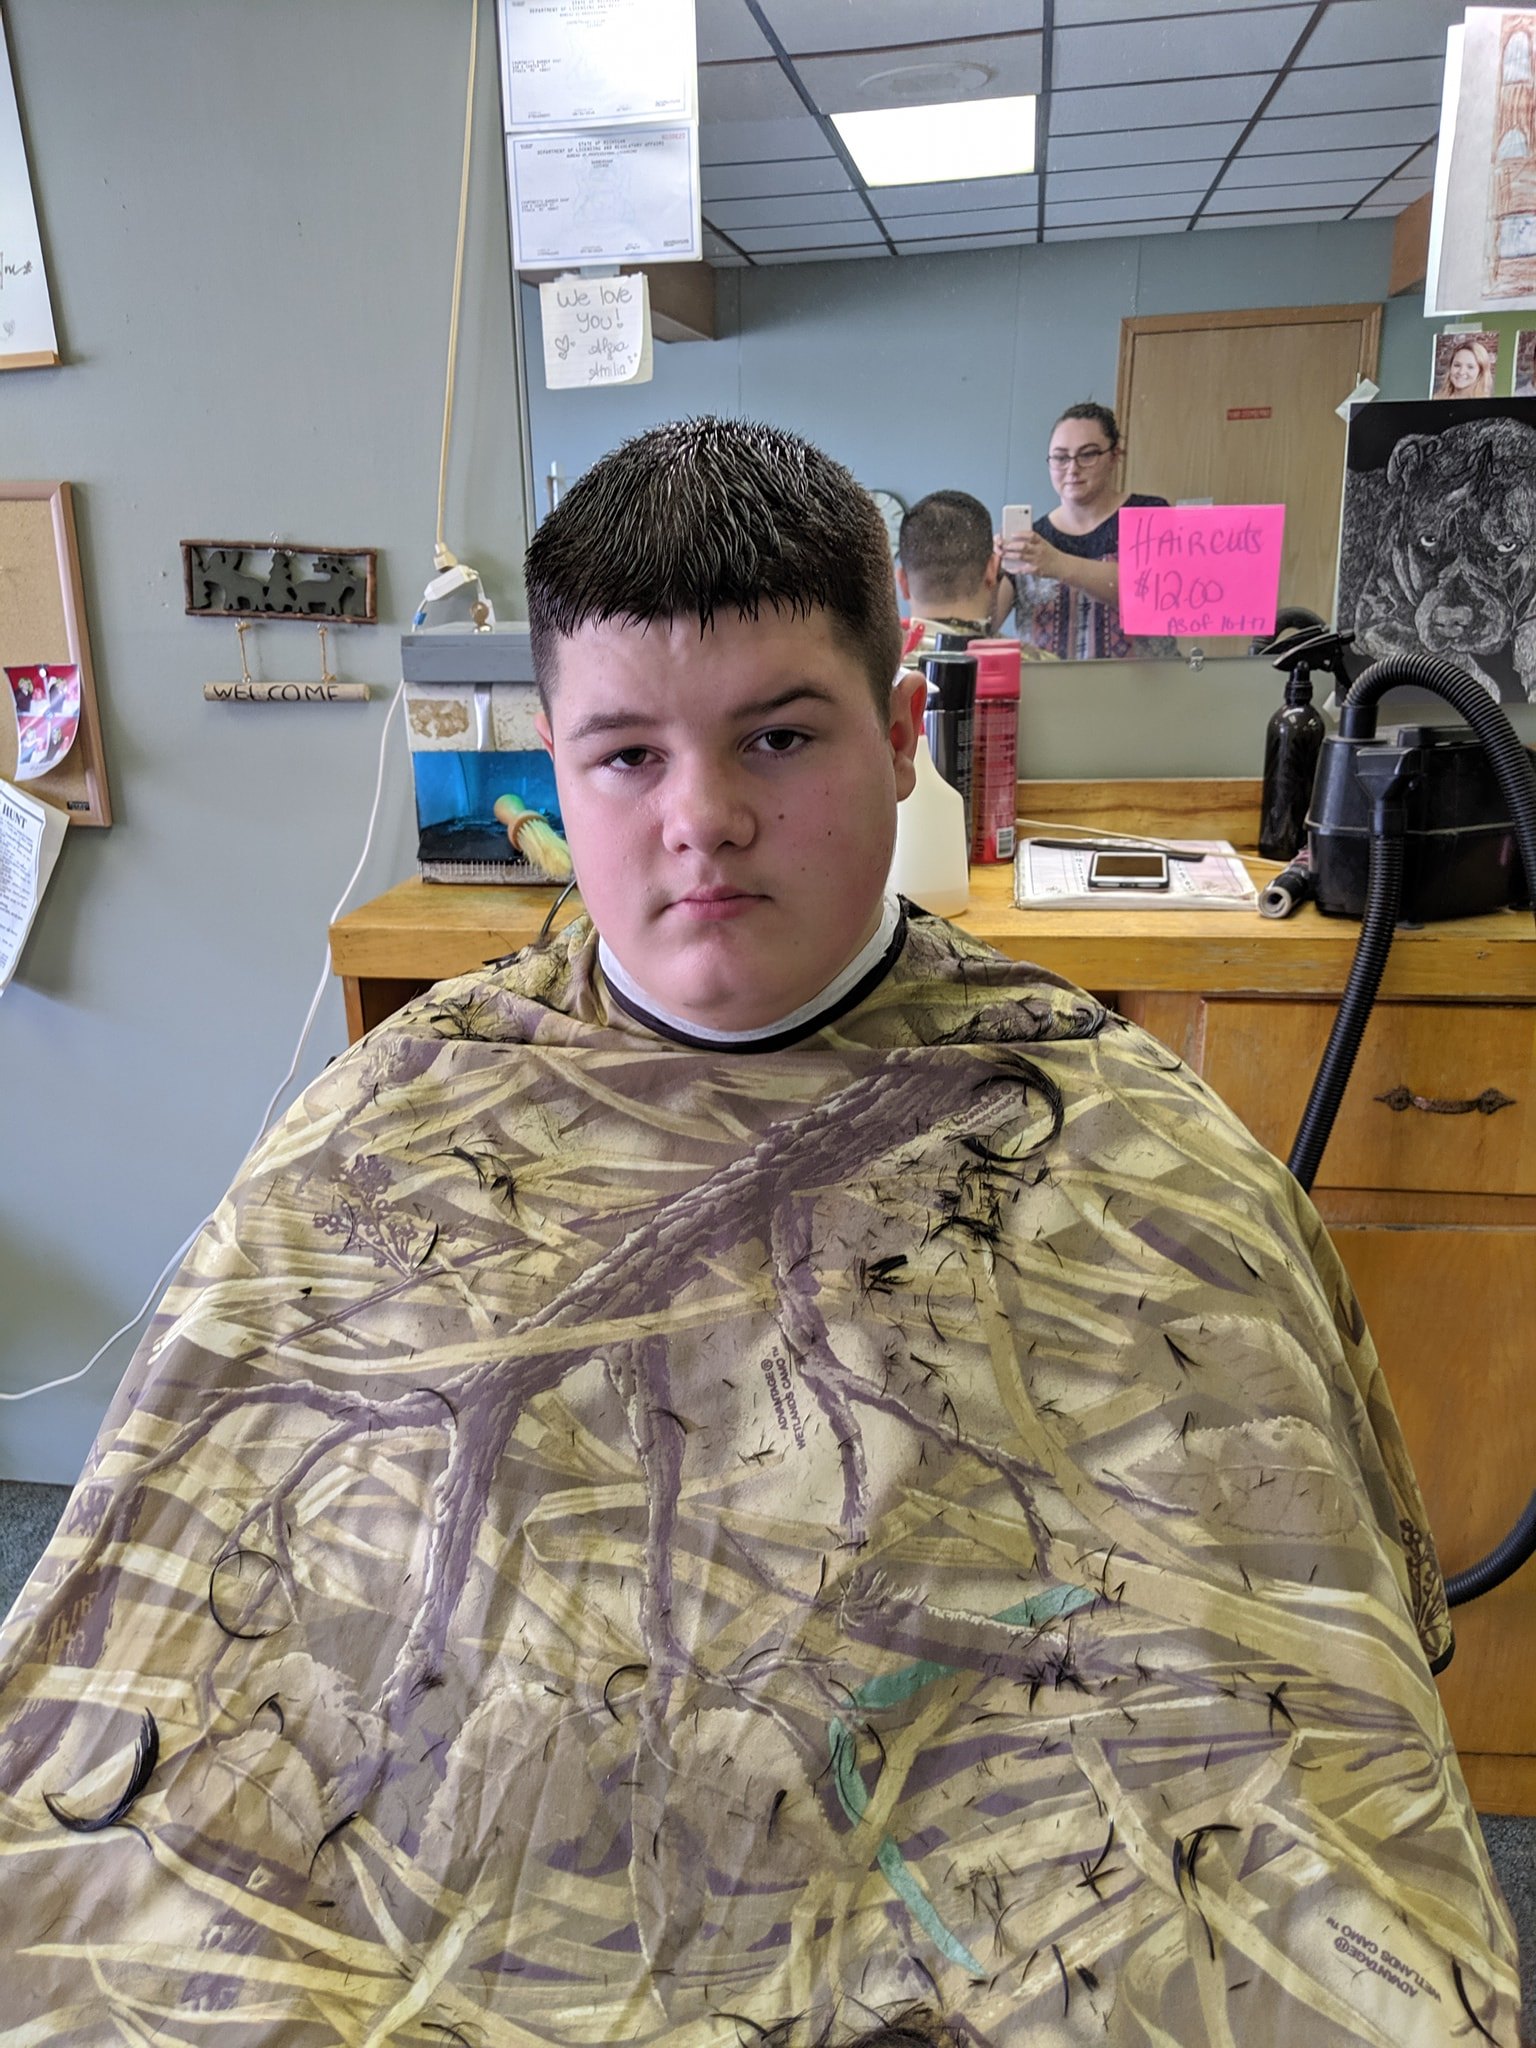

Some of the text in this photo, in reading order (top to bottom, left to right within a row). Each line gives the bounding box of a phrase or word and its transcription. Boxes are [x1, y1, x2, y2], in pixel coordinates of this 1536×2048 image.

[557, 286, 633, 308] We love
[576, 308, 624, 333] you!
[1134, 568, 1224, 611] $12.00
[2, 803, 27, 829] HUNT
[776, 1358, 792, 1389] CAMO
[785, 1391, 806, 1450] WETLANDS
[1341, 1925, 1379, 1955] CAMO
[1380, 1950, 1442, 2003] WETLANDS
